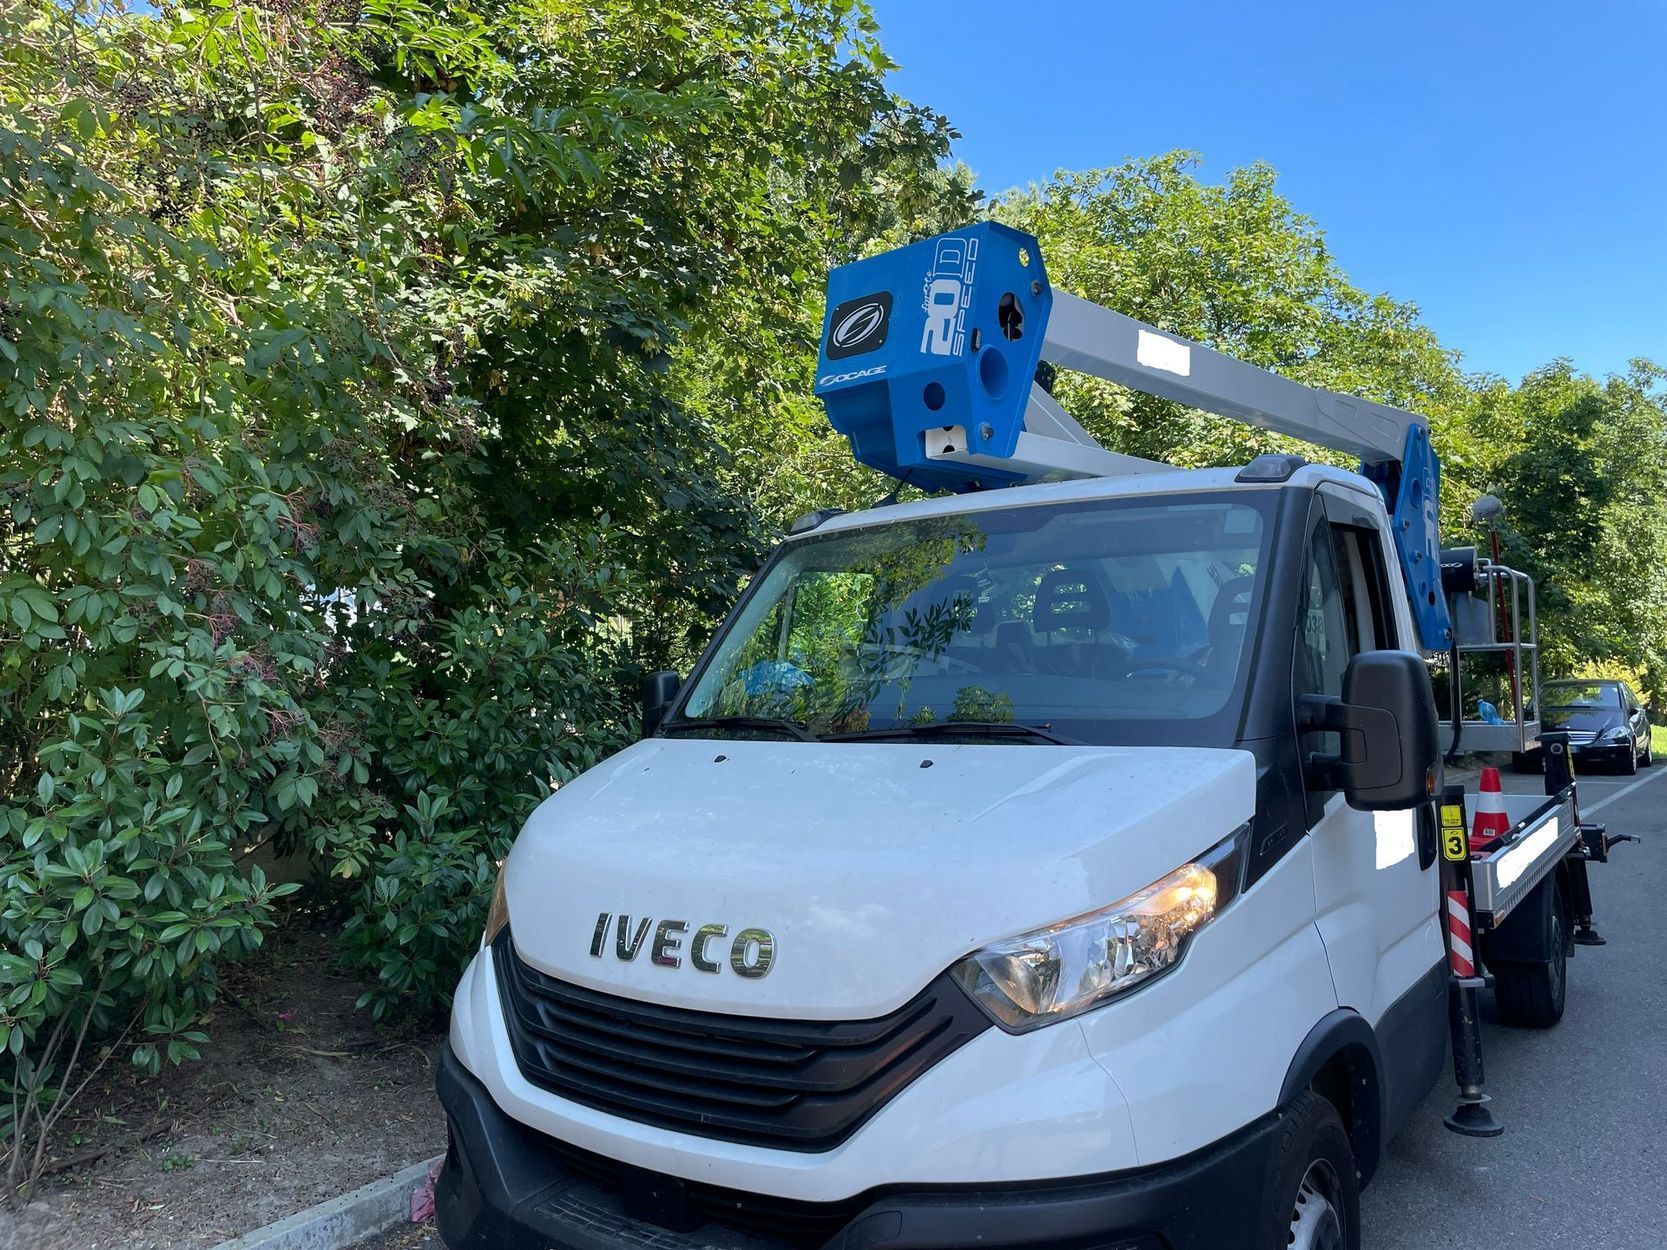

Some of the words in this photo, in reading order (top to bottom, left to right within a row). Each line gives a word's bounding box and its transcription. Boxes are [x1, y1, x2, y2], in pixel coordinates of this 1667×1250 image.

[953, 238, 979, 356] SPEED
[1448, 837, 1463, 855] 3
[589, 912, 777, 980] IVECO
